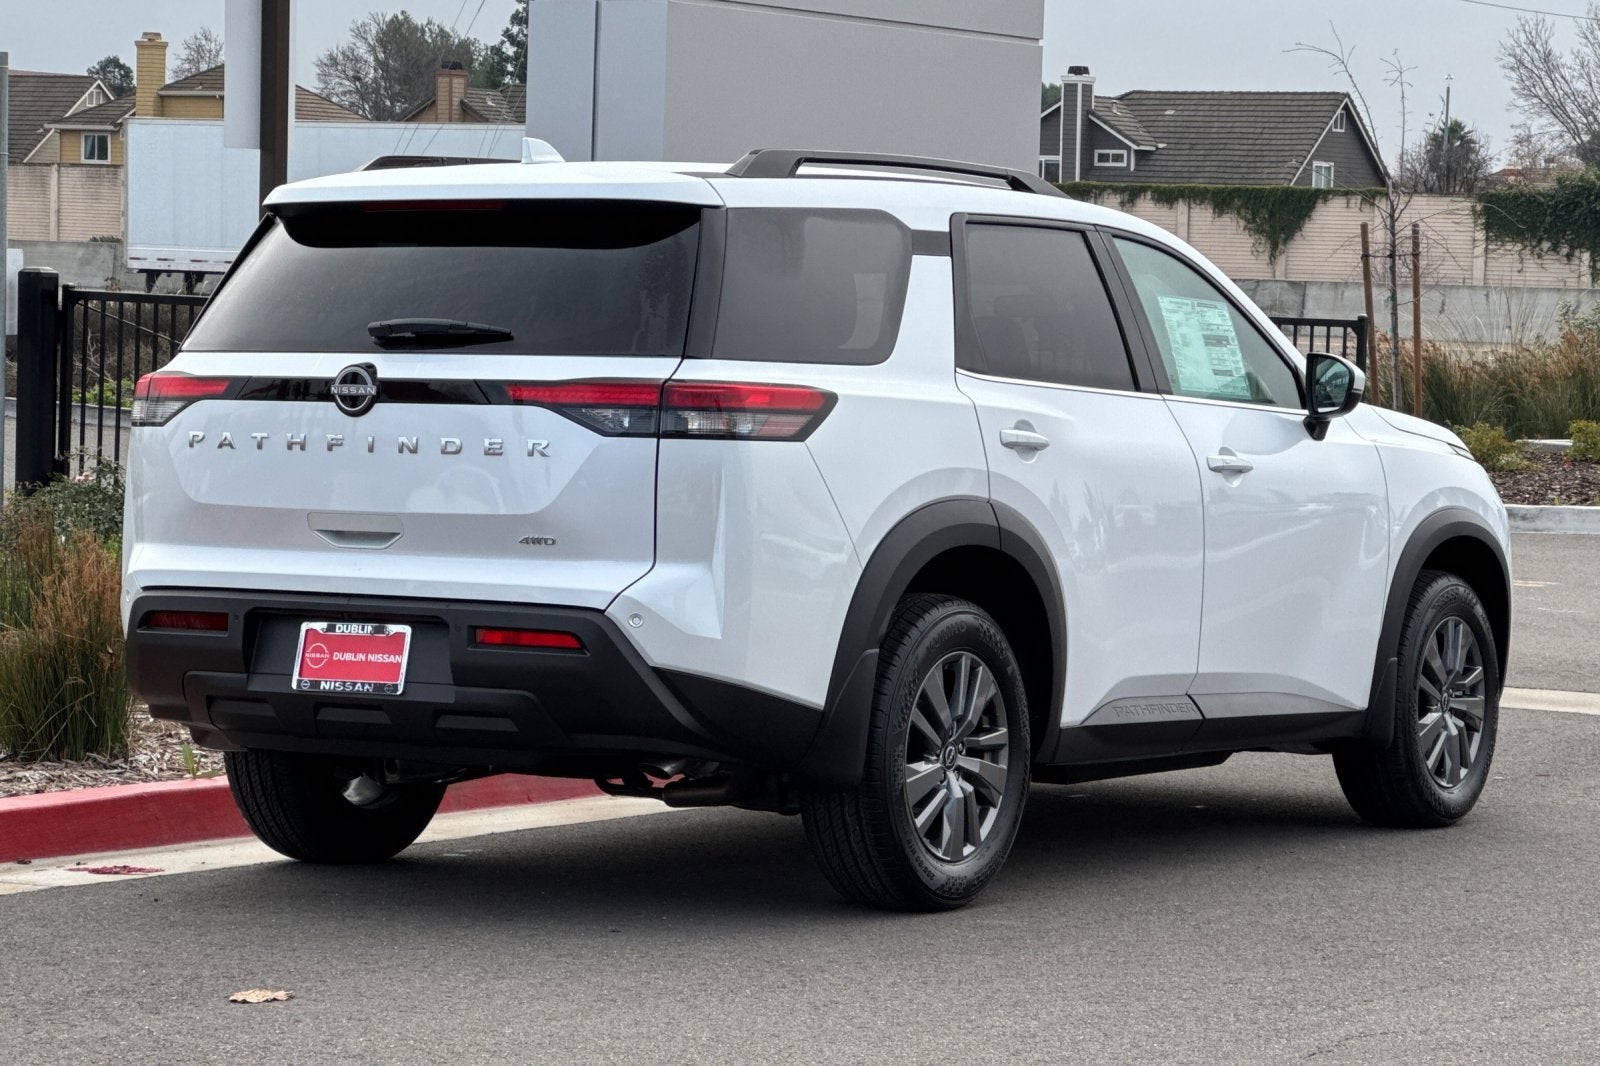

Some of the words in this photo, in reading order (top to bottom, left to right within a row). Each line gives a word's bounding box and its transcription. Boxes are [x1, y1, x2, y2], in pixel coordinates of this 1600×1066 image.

[330, 386, 376, 394] NISSAN
[187, 431, 550, 457] PATHFINDER
[518, 535, 557, 546] 4WD
[333, 651, 366, 662] DUBLIN
[367, 653, 402, 664] NISSAN
[320, 680, 374, 693] NISSAN
[1112, 702, 1197, 718] PATHFINDER
